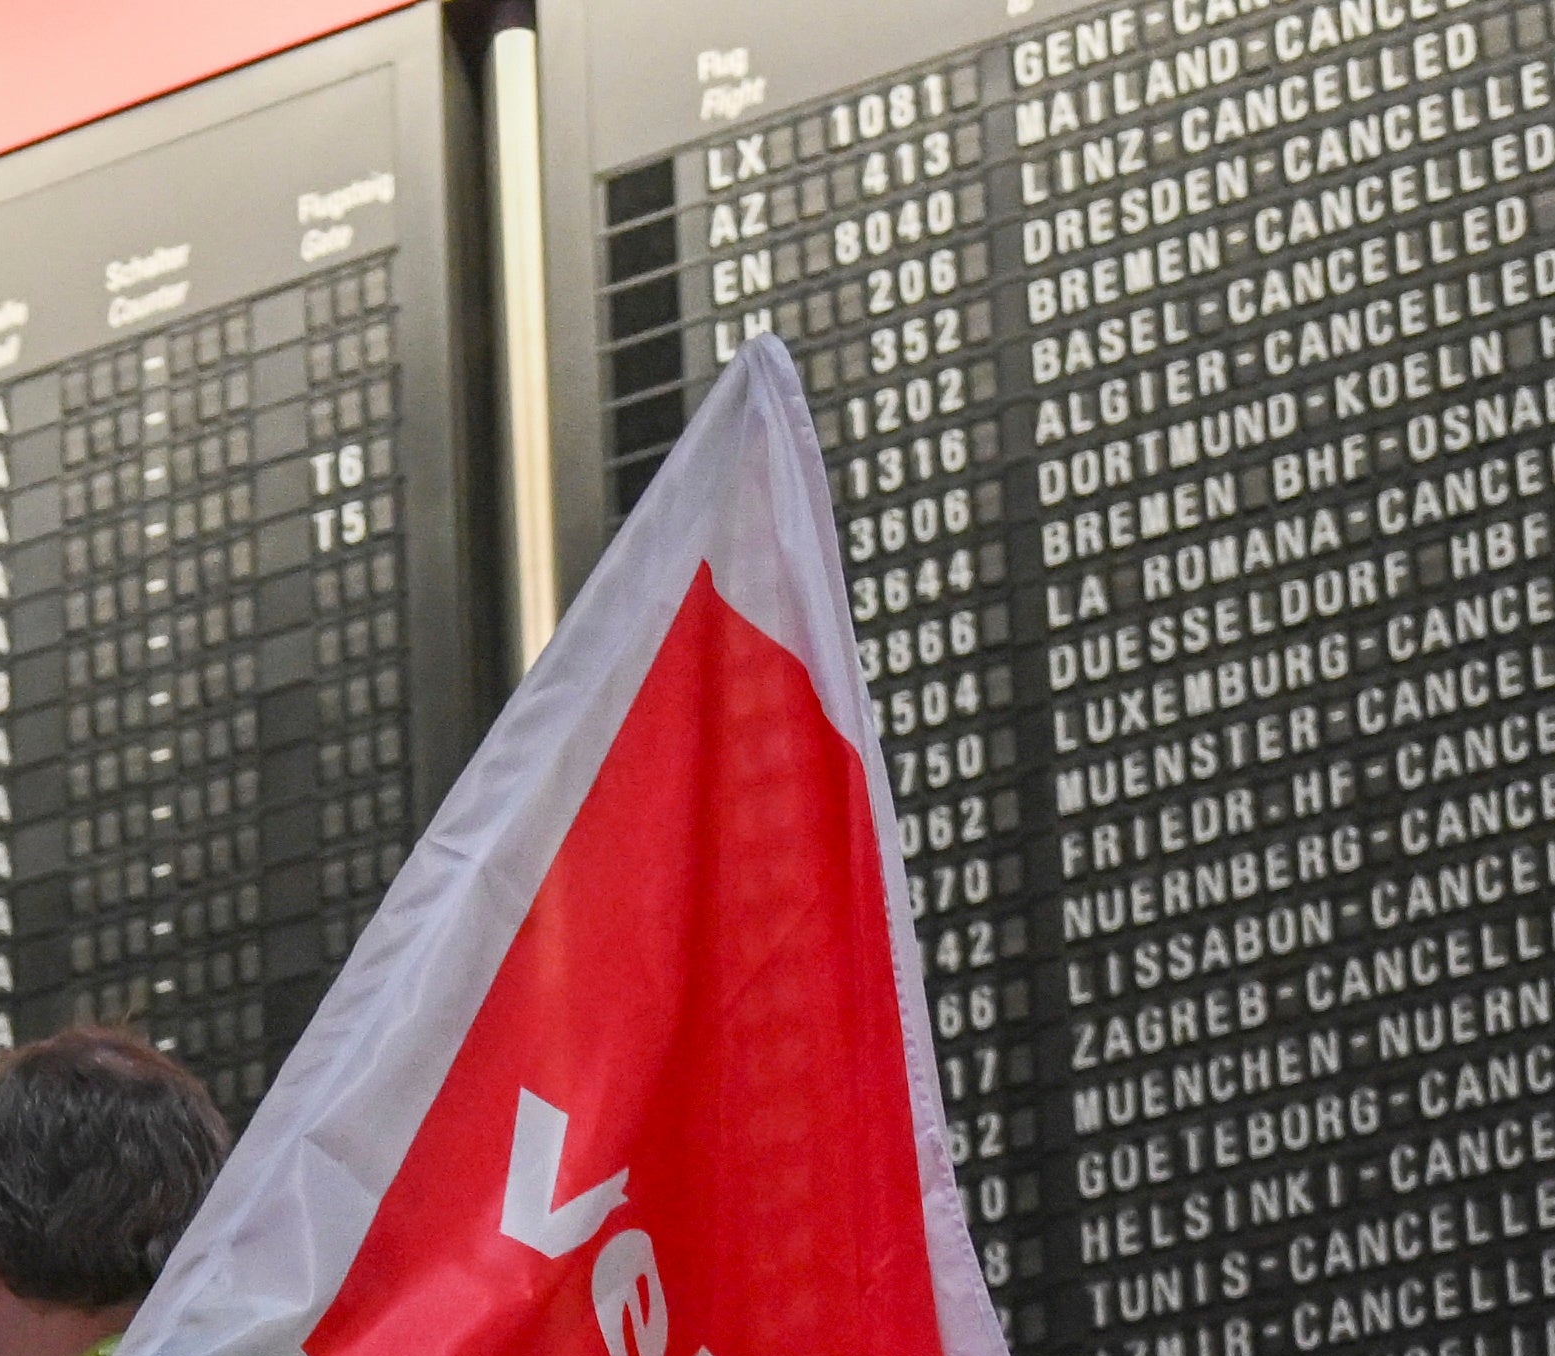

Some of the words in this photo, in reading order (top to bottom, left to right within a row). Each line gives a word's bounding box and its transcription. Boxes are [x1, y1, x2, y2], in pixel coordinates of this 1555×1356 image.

[707, 131, 767, 191] LX
[830, 68, 951, 150] 1081
[1015, 0, 1290, 85] GENF-CA
[709, 189, 770, 249] AZ
[862, 127, 954, 199] 413
[1016, 0, 1478, 145] MAILAND-CANCE
[712, 248, 773, 307] EN
[835, 186, 957, 268] 8040
[1021, 22, 1476, 205] LINZ-CANCELLED
[844, 365, 967, 446] 1202
[1031, 197, 1525, 385] BASEL-CANCELLED
[868, 245, 960, 317] 206
[871, 305, 963, 377] 352
[1028, 125, 1554, 325] BREMEN-CANCELLED
[847, 425, 970, 506] 1316
[850, 486, 973, 566] 3606
[1038, 332, 1500, 507] DORTMUND-KOELN
[853, 547, 976, 627] 3644
[1041, 472, 1233, 568] BREMEN
[1045, 571, 1105, 630] LA
[1048, 551, 1411, 692] DUESSELDORF
[1450, 513, 1550, 584] HBF
